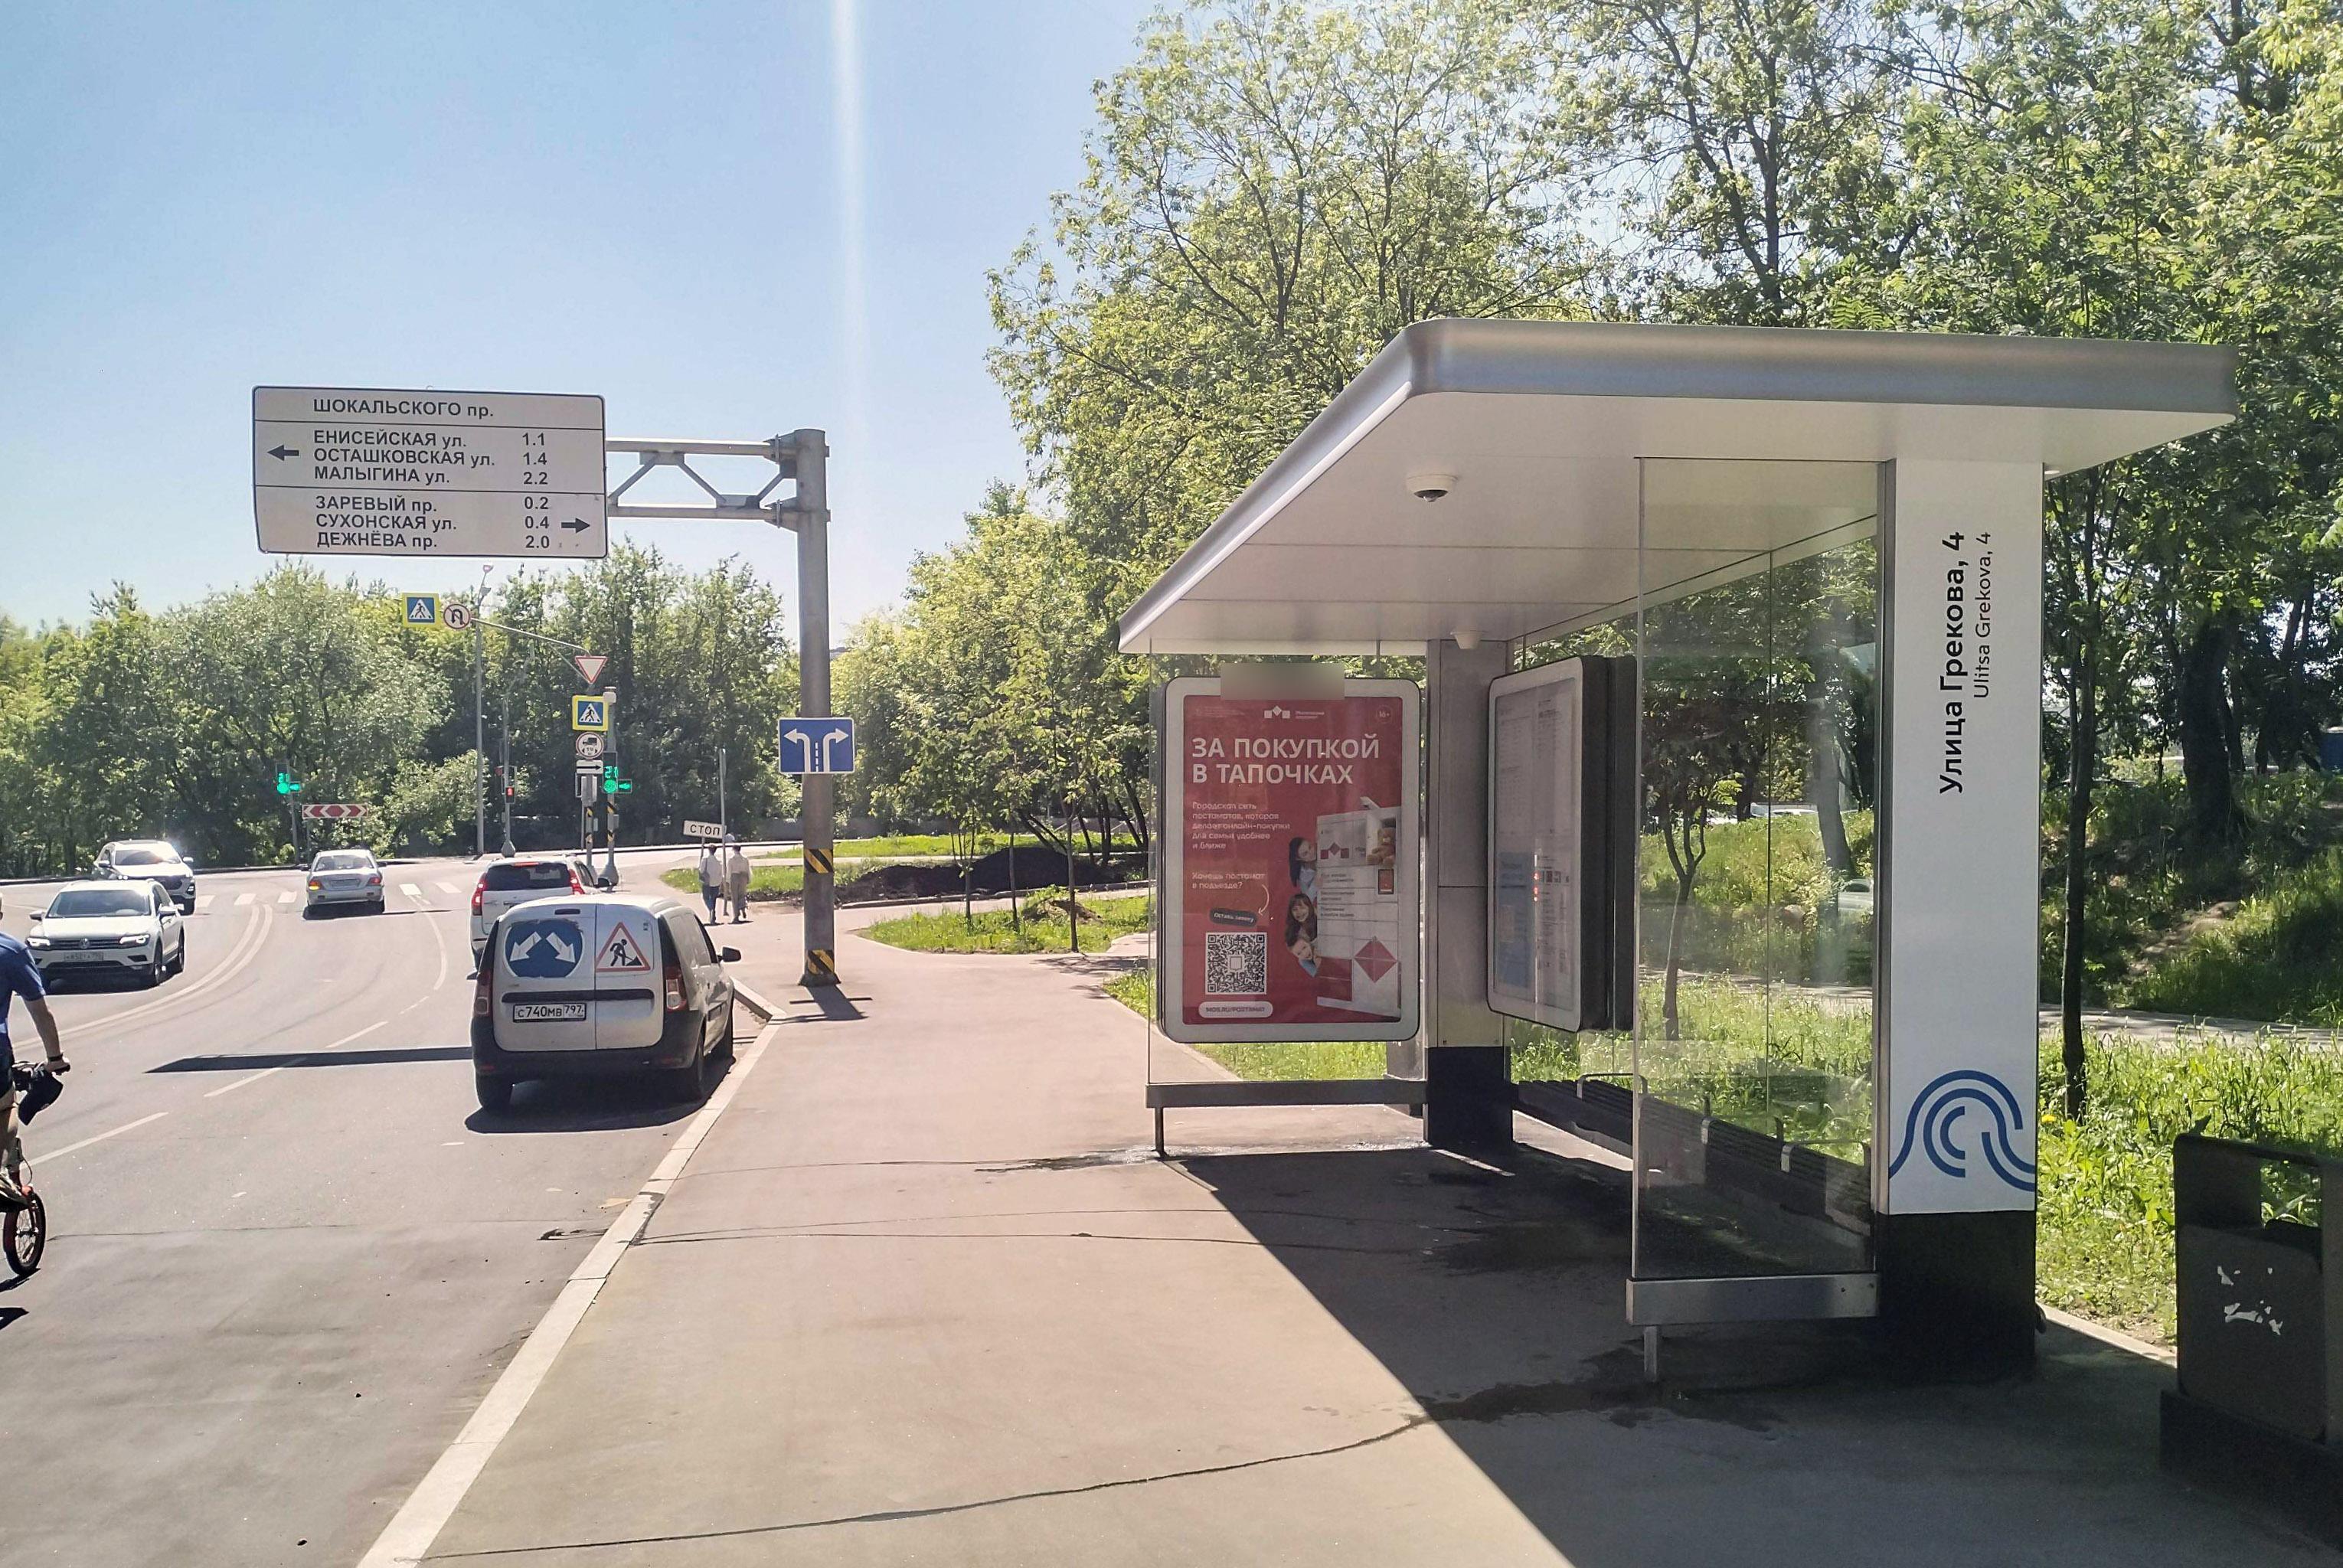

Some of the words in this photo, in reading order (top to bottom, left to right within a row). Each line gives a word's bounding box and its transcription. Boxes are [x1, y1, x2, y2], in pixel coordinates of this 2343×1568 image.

[314, 399, 461, 416] ШОКАЛЬСКОГО
[468, 407, 494, 420] пр.
[314, 429, 436, 446] ЕНИСЕЙСКАЯ
[442, 436, 466, 449] ул.
[522, 433, 544, 446] 1.1
[314, 448, 464, 466] ОСТАШКОВСКАЯ
[471, 455, 495, 469] ул.
[523, 452, 547, 466] 1.4
[315, 466, 420, 482] МАЛЫГИНА
[425, 472, 449, 486] ул.
[524, 472, 548, 485] 2.2
[315, 495, 406, 511] ЗАРЕВЫЙ
[412, 501, 437, 514] пр.
[524, 496, 549, 510] 0.2
[316, 514, 426, 530] СУХОНСКАЯ
[432, 519, 456, 533] ул.
[524, 516, 550, 530] 0.4
[317, 531, 407, 547] ДЕЖНЁВА
[412, 537, 437, 550] пр.
[525, 535, 550, 549] 2.0
[1942, 531, 1965, 551] 4
[1976, 532, 1992, 544] 4
[1975, 550, 1993, 638] Grekova,
[1940, 560, 1969, 691] Грекова,
[1973, 645, 1991, 698] Ulitsa
[1191, 737, 1225, 758] ЗА
[1234, 733, 1379, 759] ПОКУПКОЙ
[1939, 701, 1966, 794] Улица
[1192, 764, 1207, 783] В
[1216, 764, 1353, 784] ТАПОЧКАХ
[690, 825, 720, 835] СТОП
[518, 1006, 562, 1018] С740МВ
